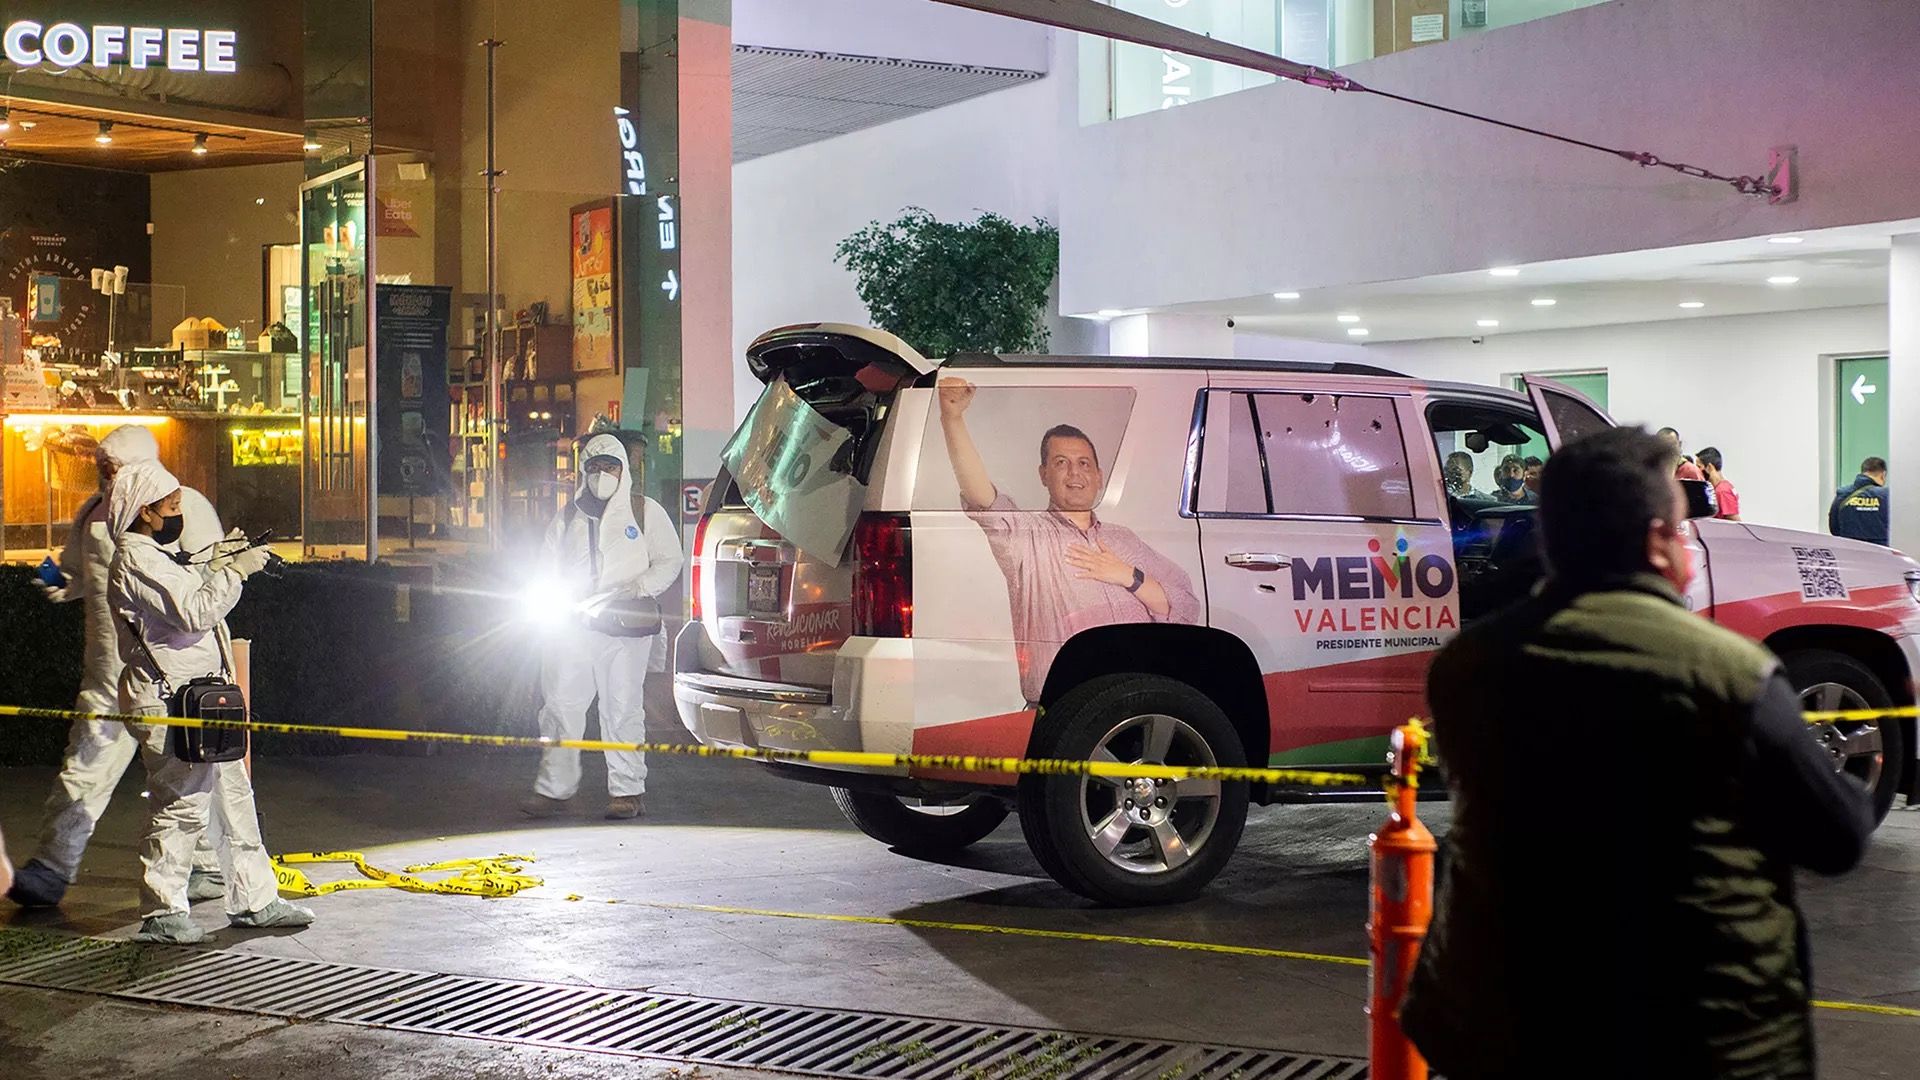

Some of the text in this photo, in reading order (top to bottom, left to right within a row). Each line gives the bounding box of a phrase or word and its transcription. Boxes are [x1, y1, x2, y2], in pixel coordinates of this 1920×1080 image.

[3, 21, 237, 72] COFFEE
[384, 197, 412, 209] Uber
[384, 209, 413, 220] Eats
[1291, 554, 1454, 601] MEMO
[1294, 605, 1456, 633] VALENCIA
[1316, 637, 1441, 650] PRESIDENTE MUNICIPAL
